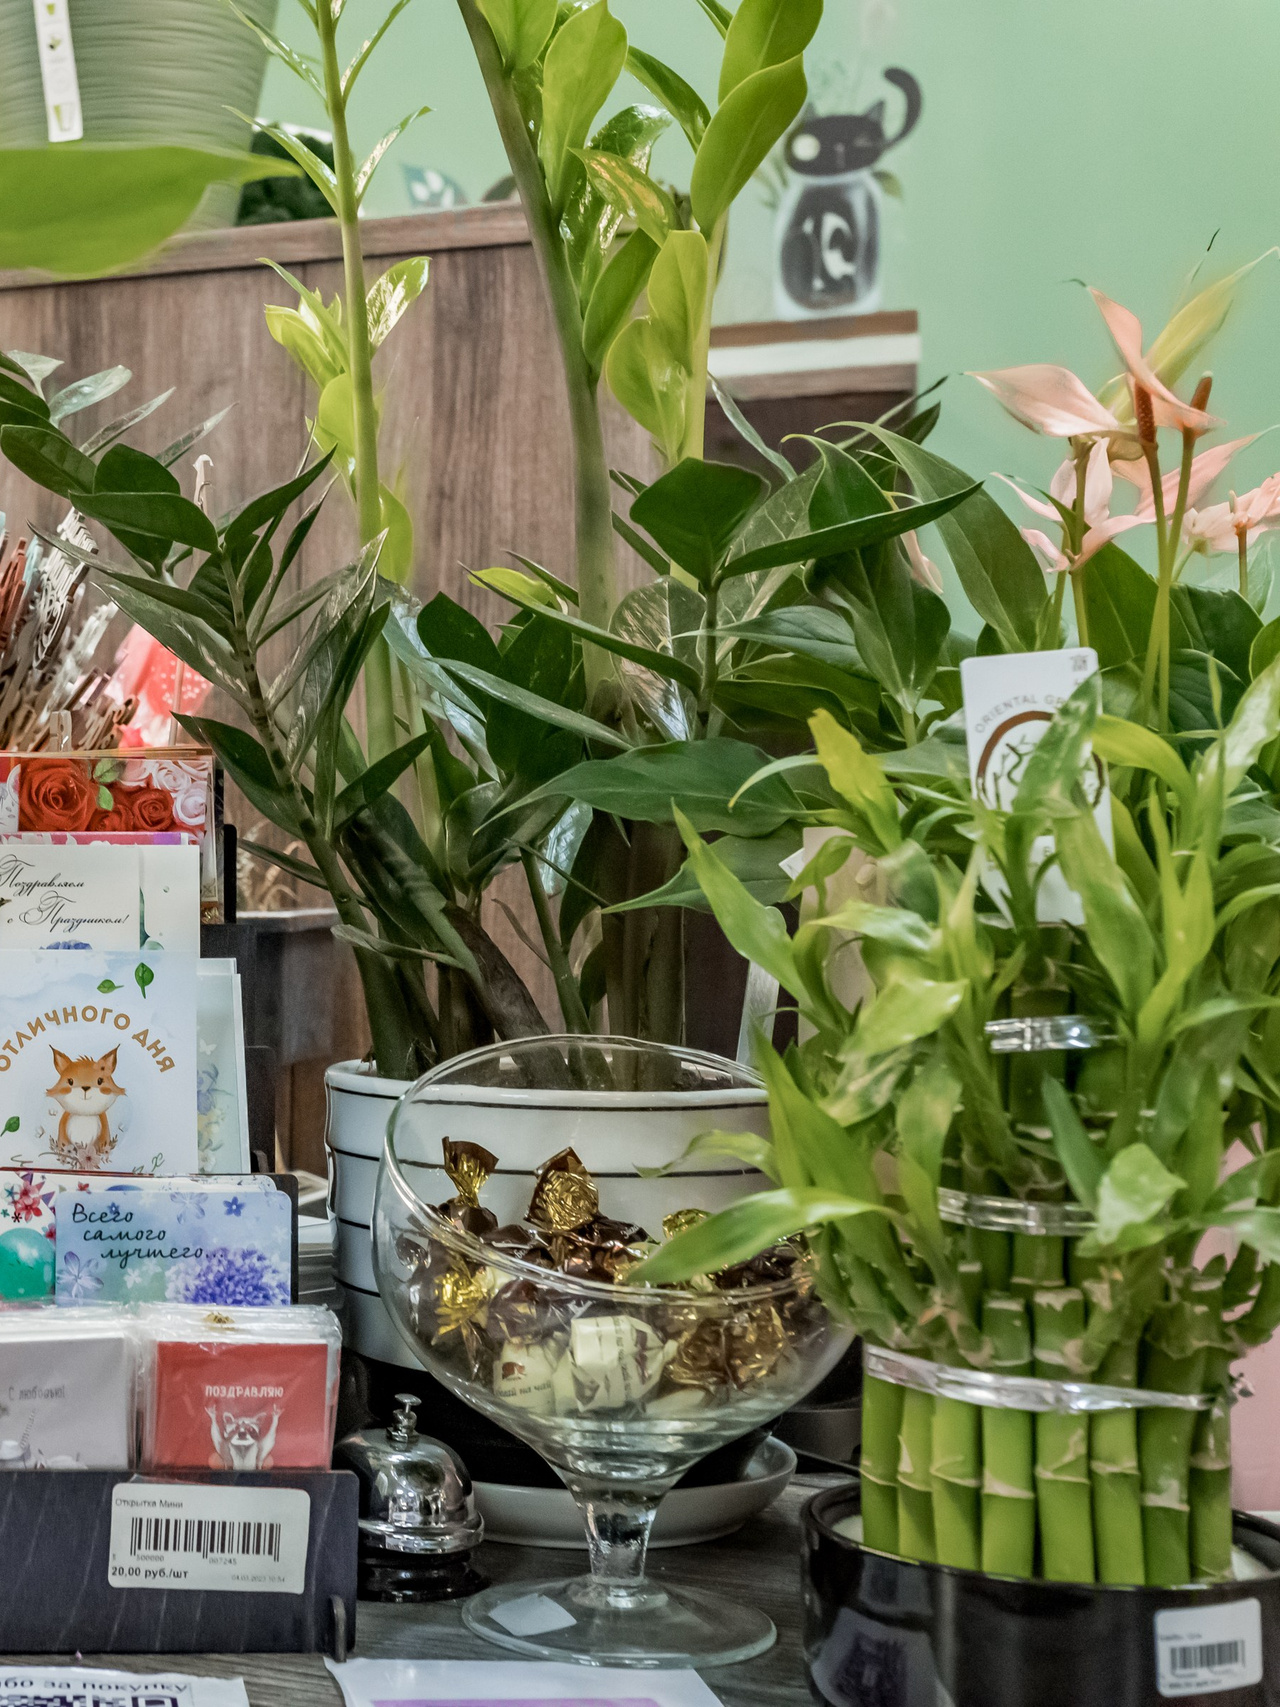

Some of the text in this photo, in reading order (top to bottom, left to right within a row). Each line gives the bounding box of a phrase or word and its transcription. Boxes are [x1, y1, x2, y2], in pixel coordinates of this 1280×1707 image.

[19, 890, 130, 933] Праздником!
[131, 1028, 175, 1073] ДНЯ
[72, 1203, 134, 1223] Всего
[83, 1229, 167, 1241] самого
[205, 1385, 284, 1399] ПОЗДРАВЛЯЮ
[115, 1498, 184, 1509] Открытка Мини
[111, 1565, 189, 1580] 20,00 руб./шт
[44, 1681, 71, 1689] за
[82, 1682, 187, 1692] покупку
